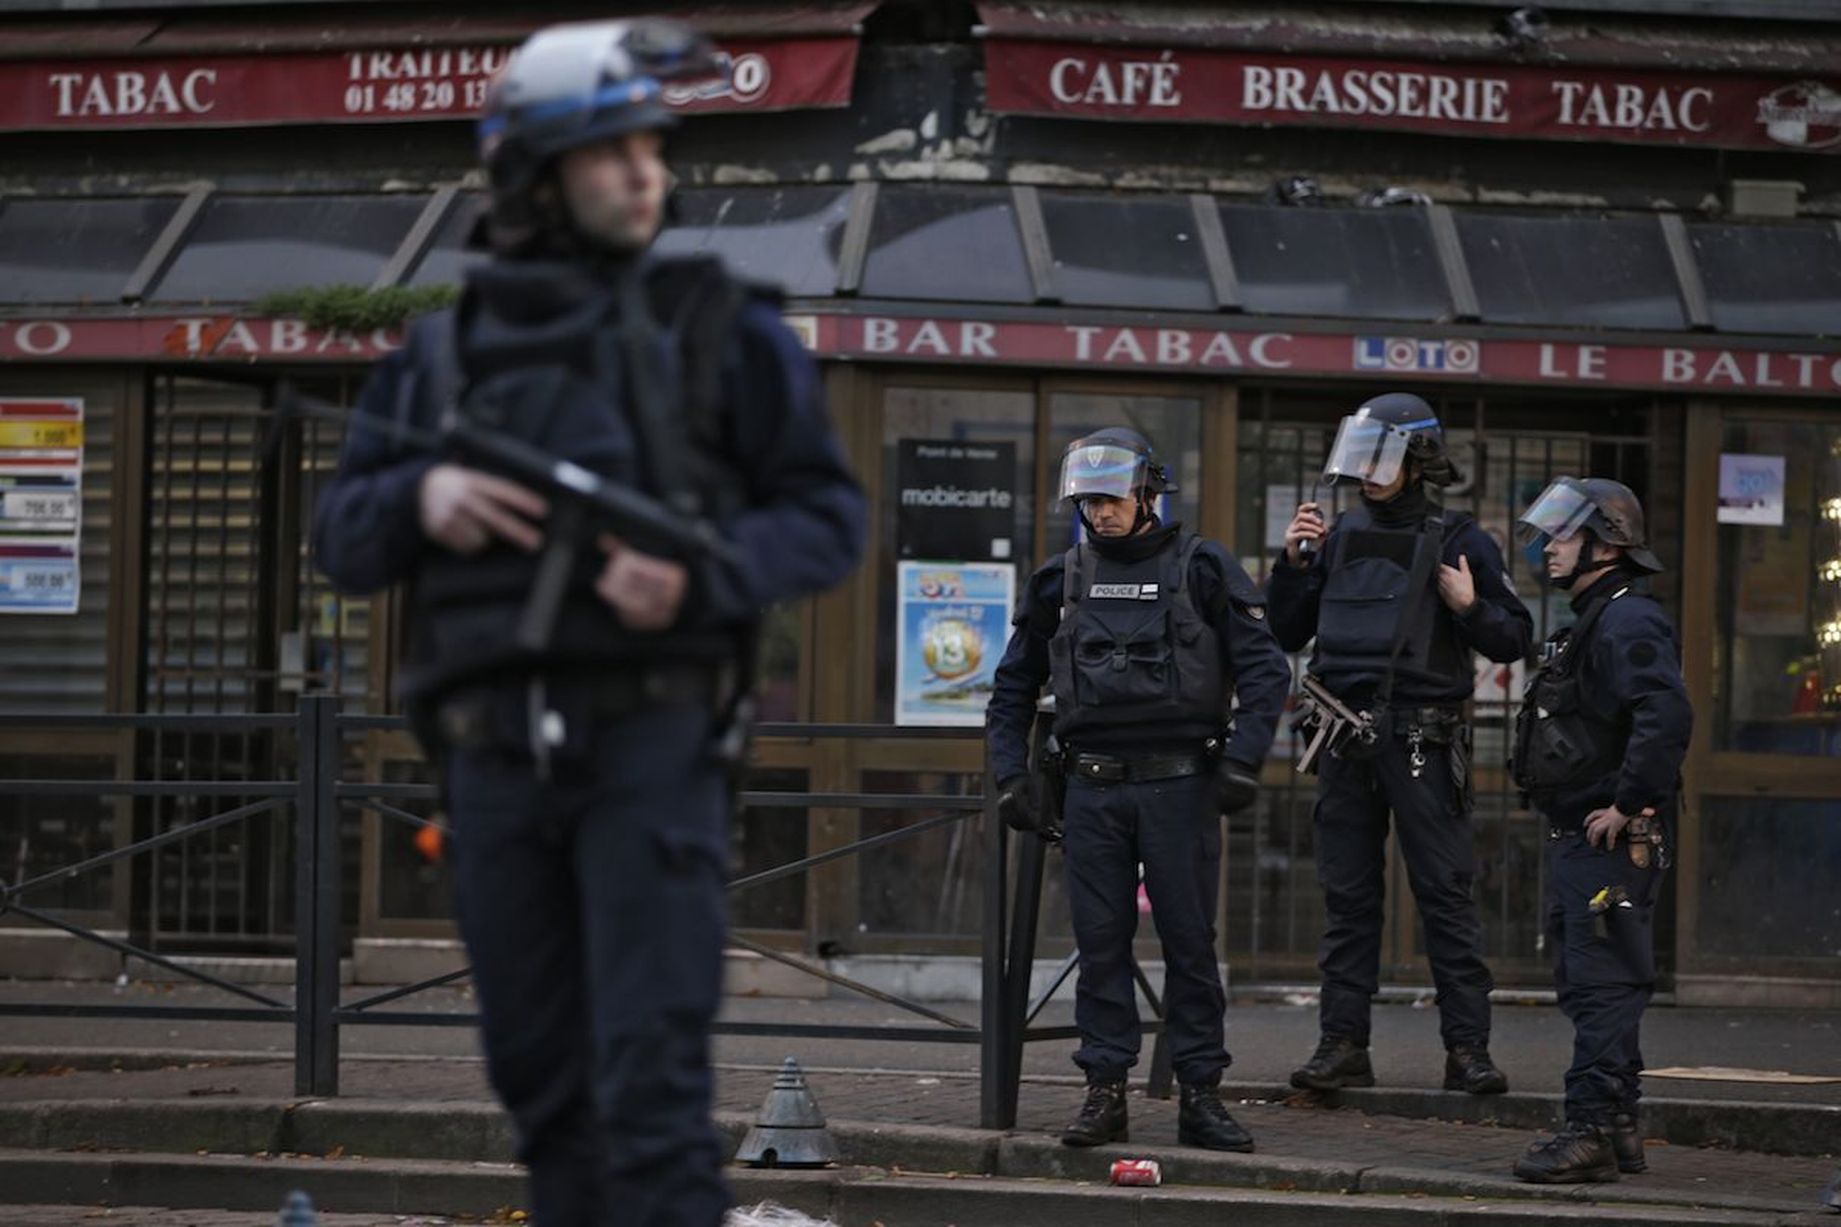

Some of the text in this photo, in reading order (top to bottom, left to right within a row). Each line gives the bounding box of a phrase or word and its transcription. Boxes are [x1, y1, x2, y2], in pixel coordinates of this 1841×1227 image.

[344, 47, 506, 79] TRAITEU
[48, 69, 217, 117] TABAC
[344, 85, 375, 113] 01
[382, 83, 416, 111] 48
[421, 82, 454, 110] 20
[1049, 50, 1181, 107] CAFÉ
[1241, 65, 1510, 124] BRASSERIE
[1552, 81, 1713, 132] TABAC
[862, 317, 1294, 368] BAR TABAC
[1356, 337, 1476, 370] LOTO
[1538, 343, 1841, 387] LE BALT
[902, 485, 1012, 509] mobicarte
[1095, 586, 1136, 596] POLICE
